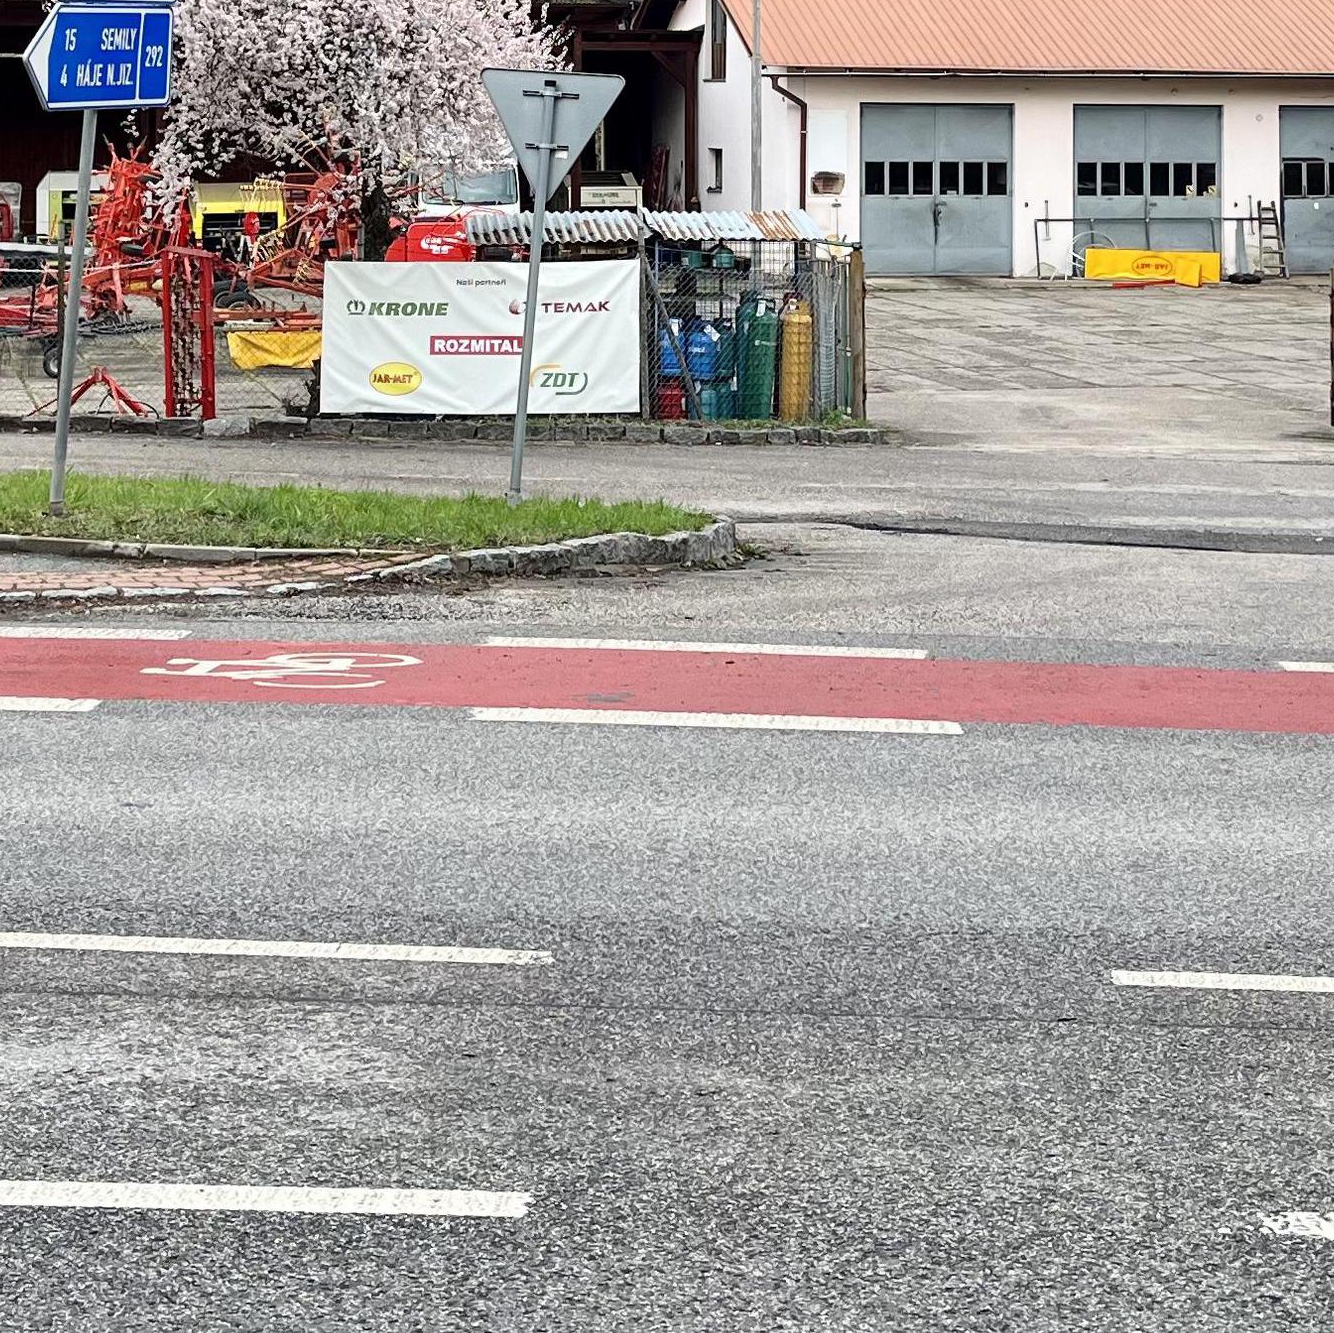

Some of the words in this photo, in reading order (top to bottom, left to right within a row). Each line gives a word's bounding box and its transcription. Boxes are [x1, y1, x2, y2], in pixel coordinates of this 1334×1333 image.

[65, 28, 77, 52] 15
[100, 27, 138, 51] SEMILY
[145, 45, 163, 67] 292
[60, 64, 67, 86] 4
[76, 58, 104, 87] HÁJE
[368, 301, 450, 317] KRONE
[540, 300, 611, 314] TEMAK
[434, 339, 523, 354] ROZMITAL
[372, 373, 413, 384] JAR-MET
[540, 372, 580, 388] ZDT
